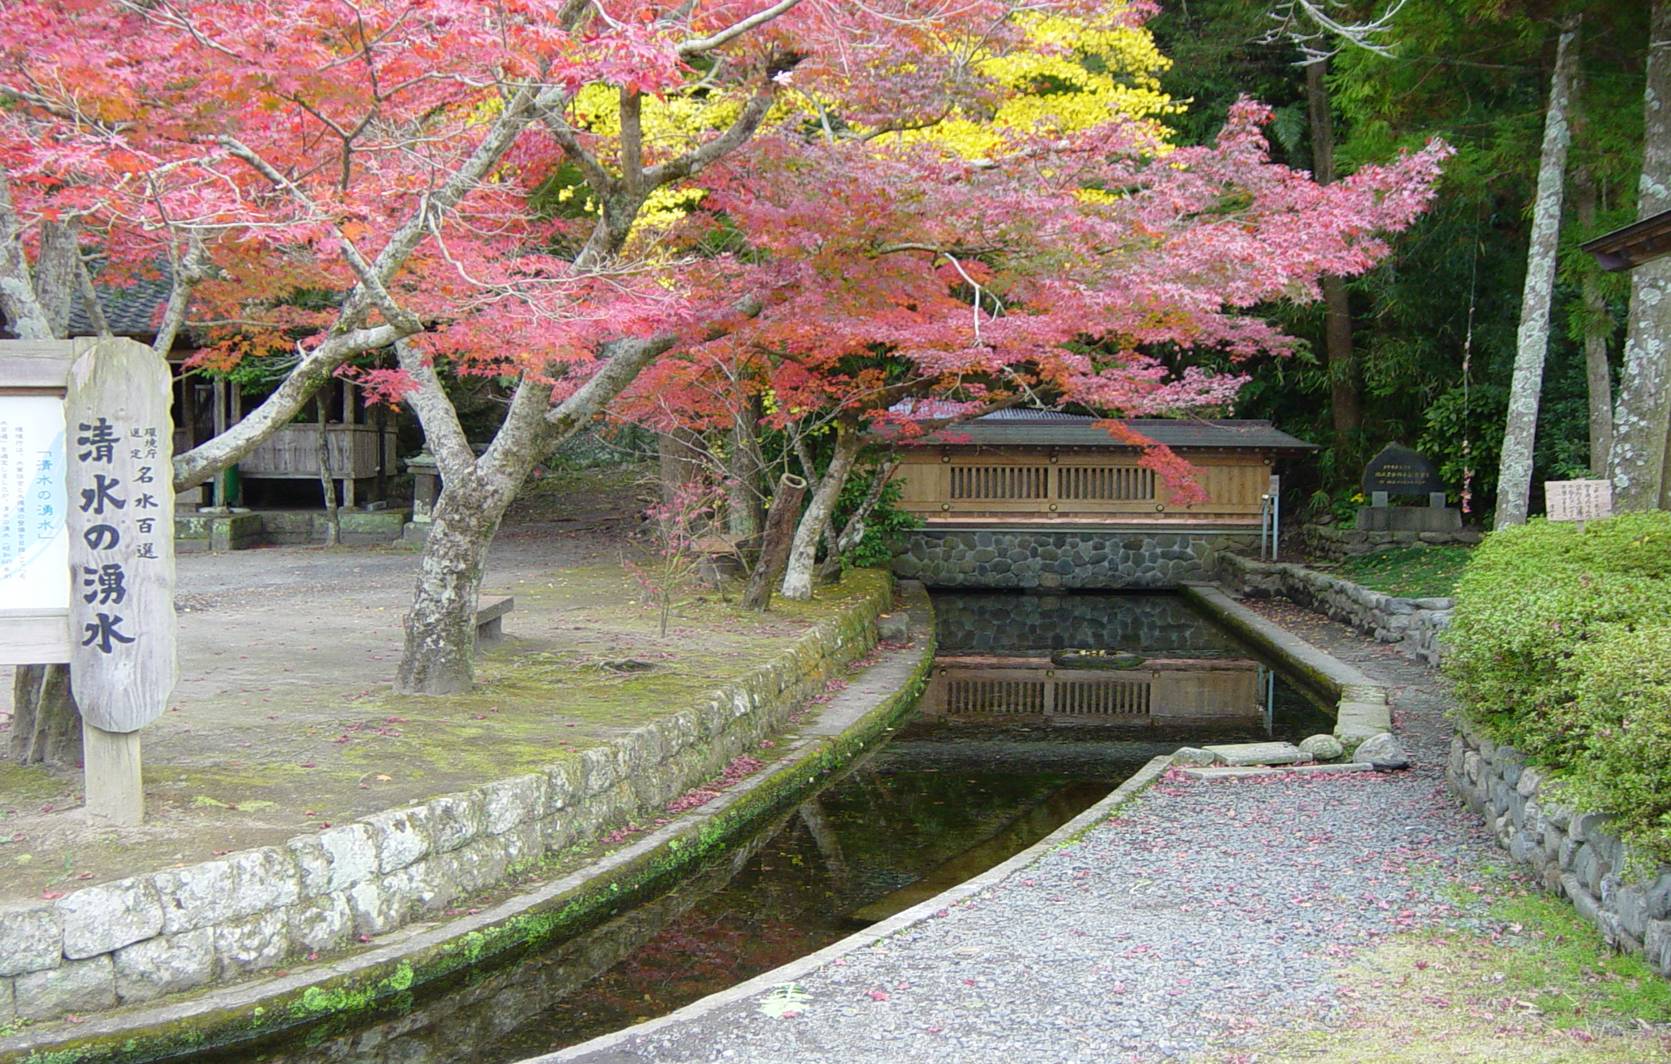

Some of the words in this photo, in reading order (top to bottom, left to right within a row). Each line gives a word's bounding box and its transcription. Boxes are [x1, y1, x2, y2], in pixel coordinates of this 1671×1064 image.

[144, 427, 158, 460] 環境庁
[77, 417, 136, 655] 清水の湧水
[133, 466, 159, 560] 名水百選
